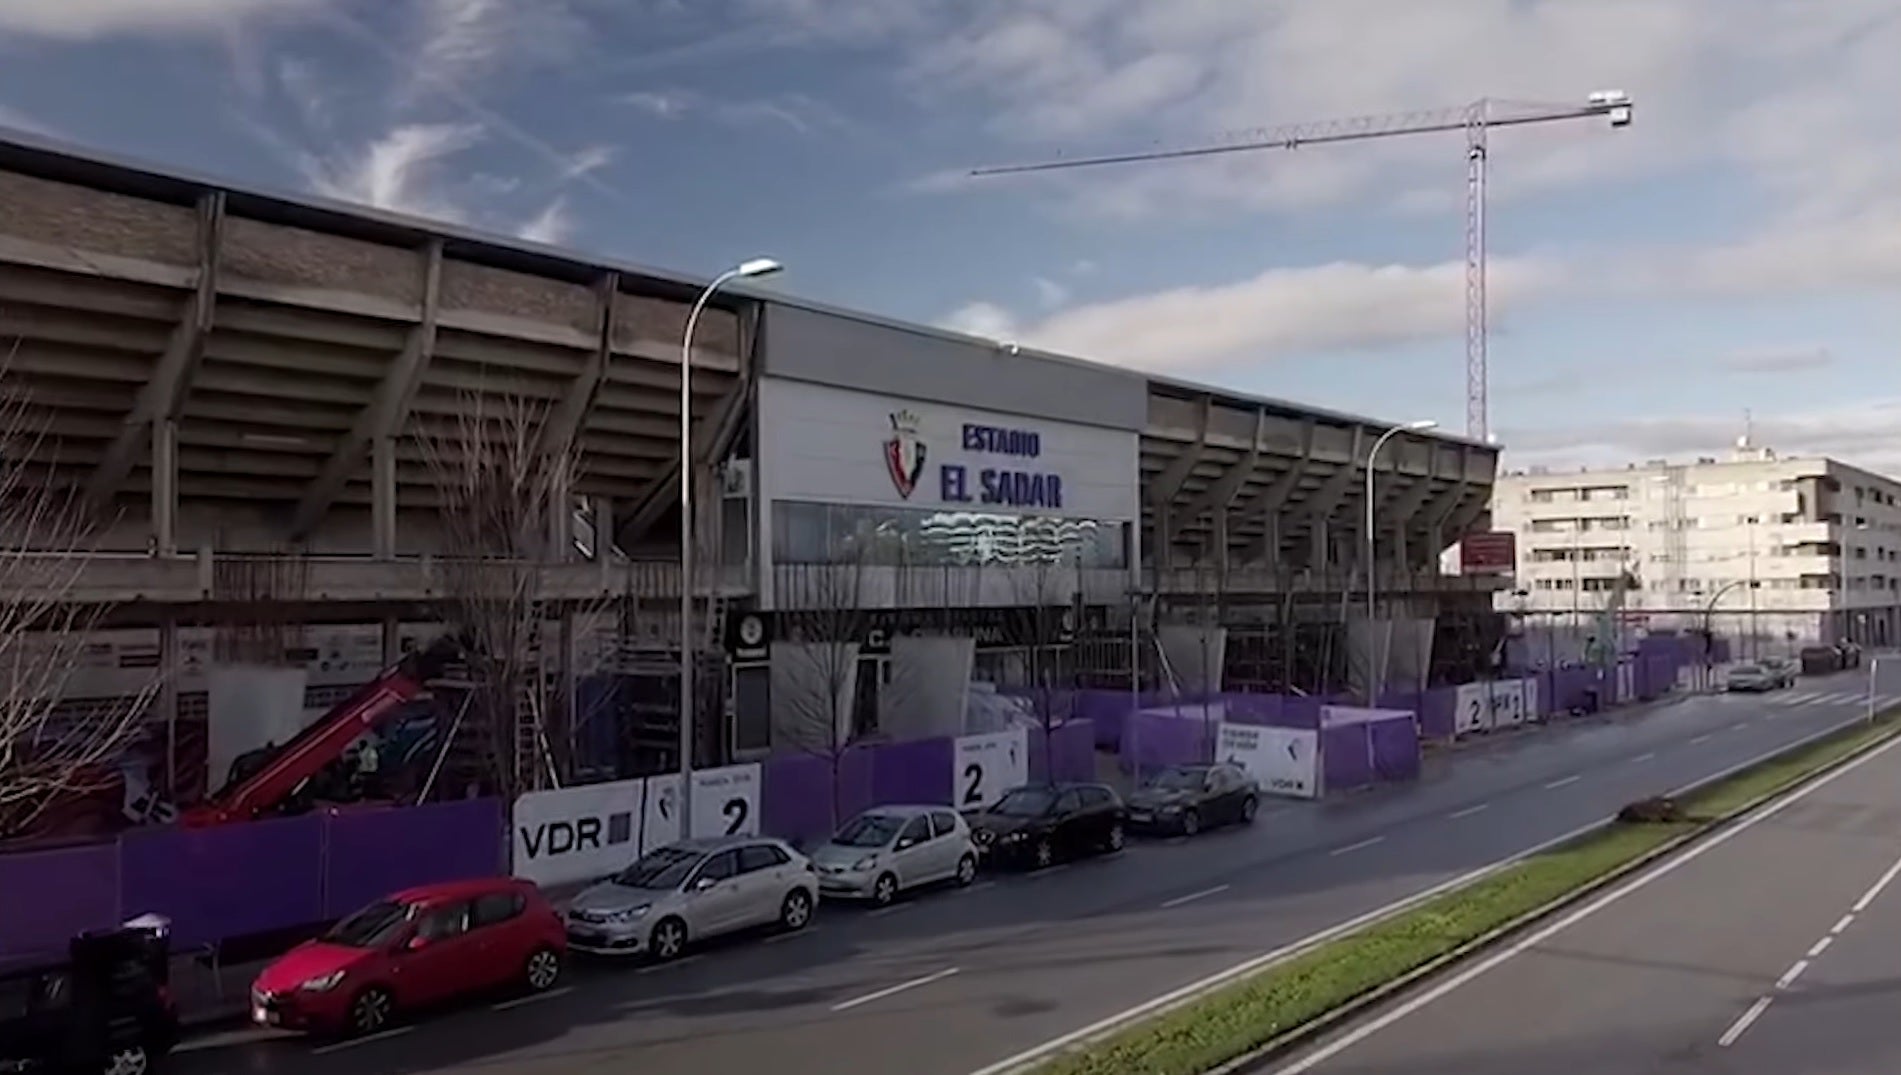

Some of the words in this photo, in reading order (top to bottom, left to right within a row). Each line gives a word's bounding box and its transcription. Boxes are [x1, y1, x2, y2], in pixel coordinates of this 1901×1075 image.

[963, 423, 1040, 458] ESTADIO
[941, 465, 973, 501] EL
[980, 468, 1062, 508] SADAR
[1471, 700, 1480, 724] 2
[963, 763, 983, 804] 2
[723, 797, 747, 836] 2
[520, 817, 602, 859] VDR
